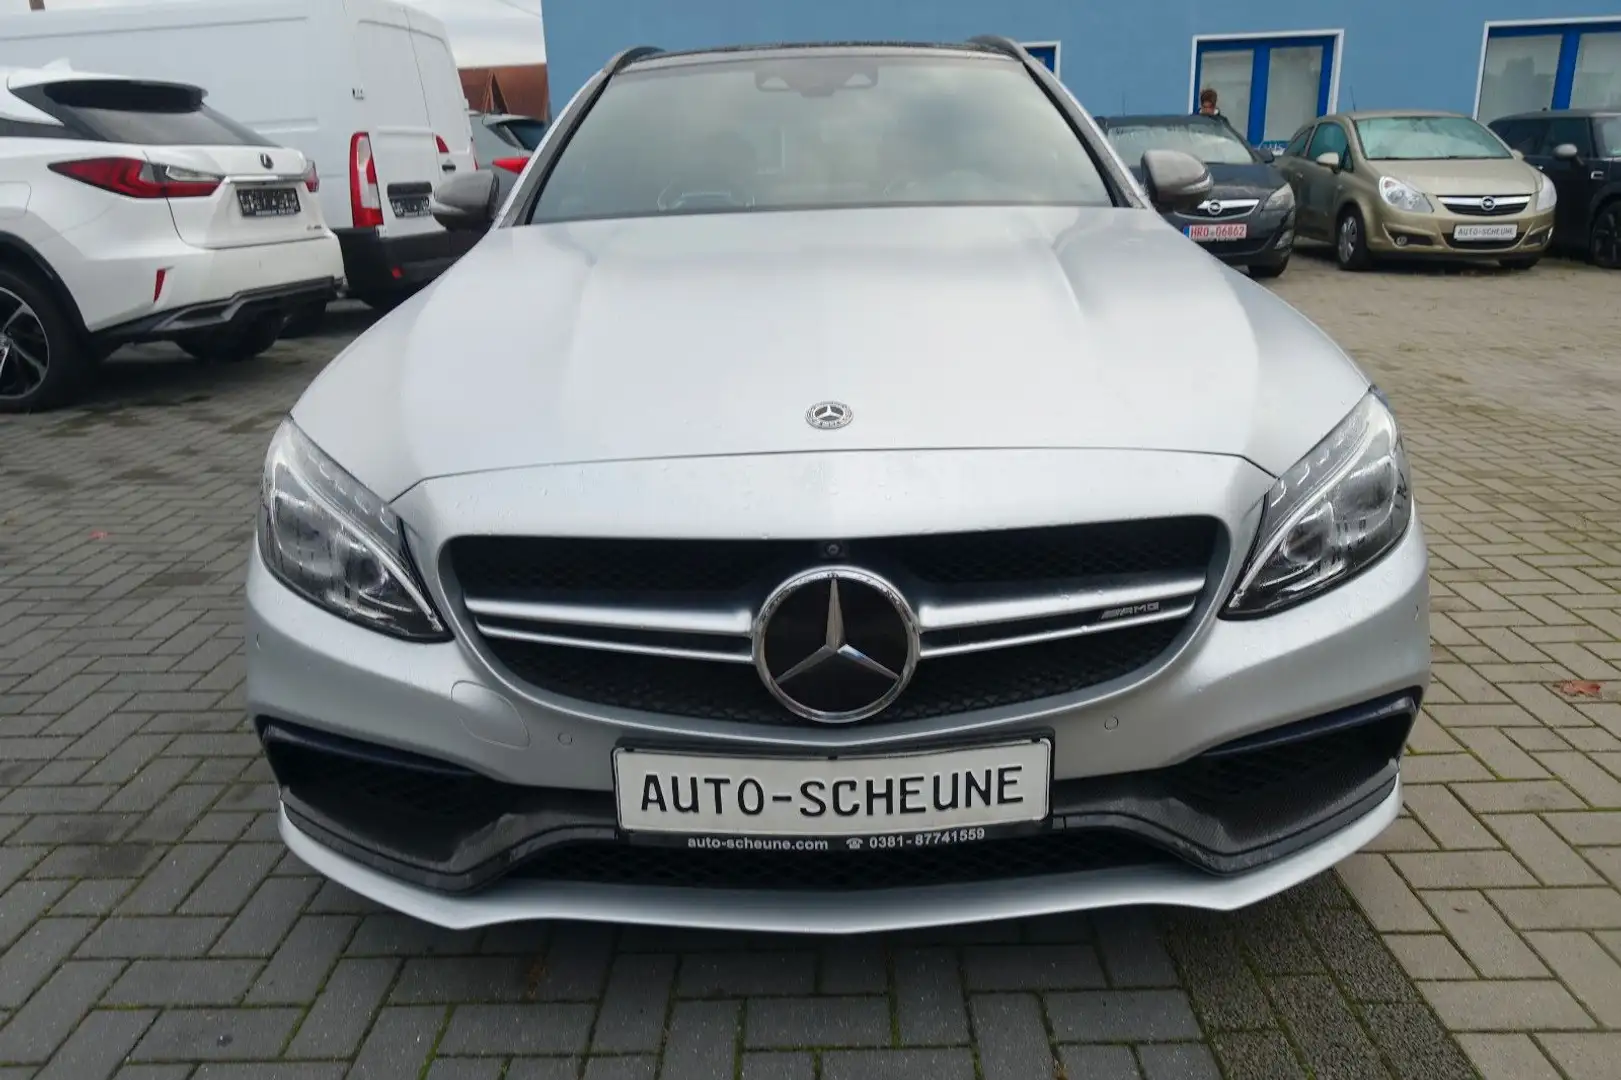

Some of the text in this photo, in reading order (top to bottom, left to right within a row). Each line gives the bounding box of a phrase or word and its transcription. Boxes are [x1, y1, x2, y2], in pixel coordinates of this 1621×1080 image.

[1116, 602, 1159, 616] AMG
[641, 765, 1024, 817] AUTO-SCHEUNE
[688, 837, 829, 850] auto-scheune.com
